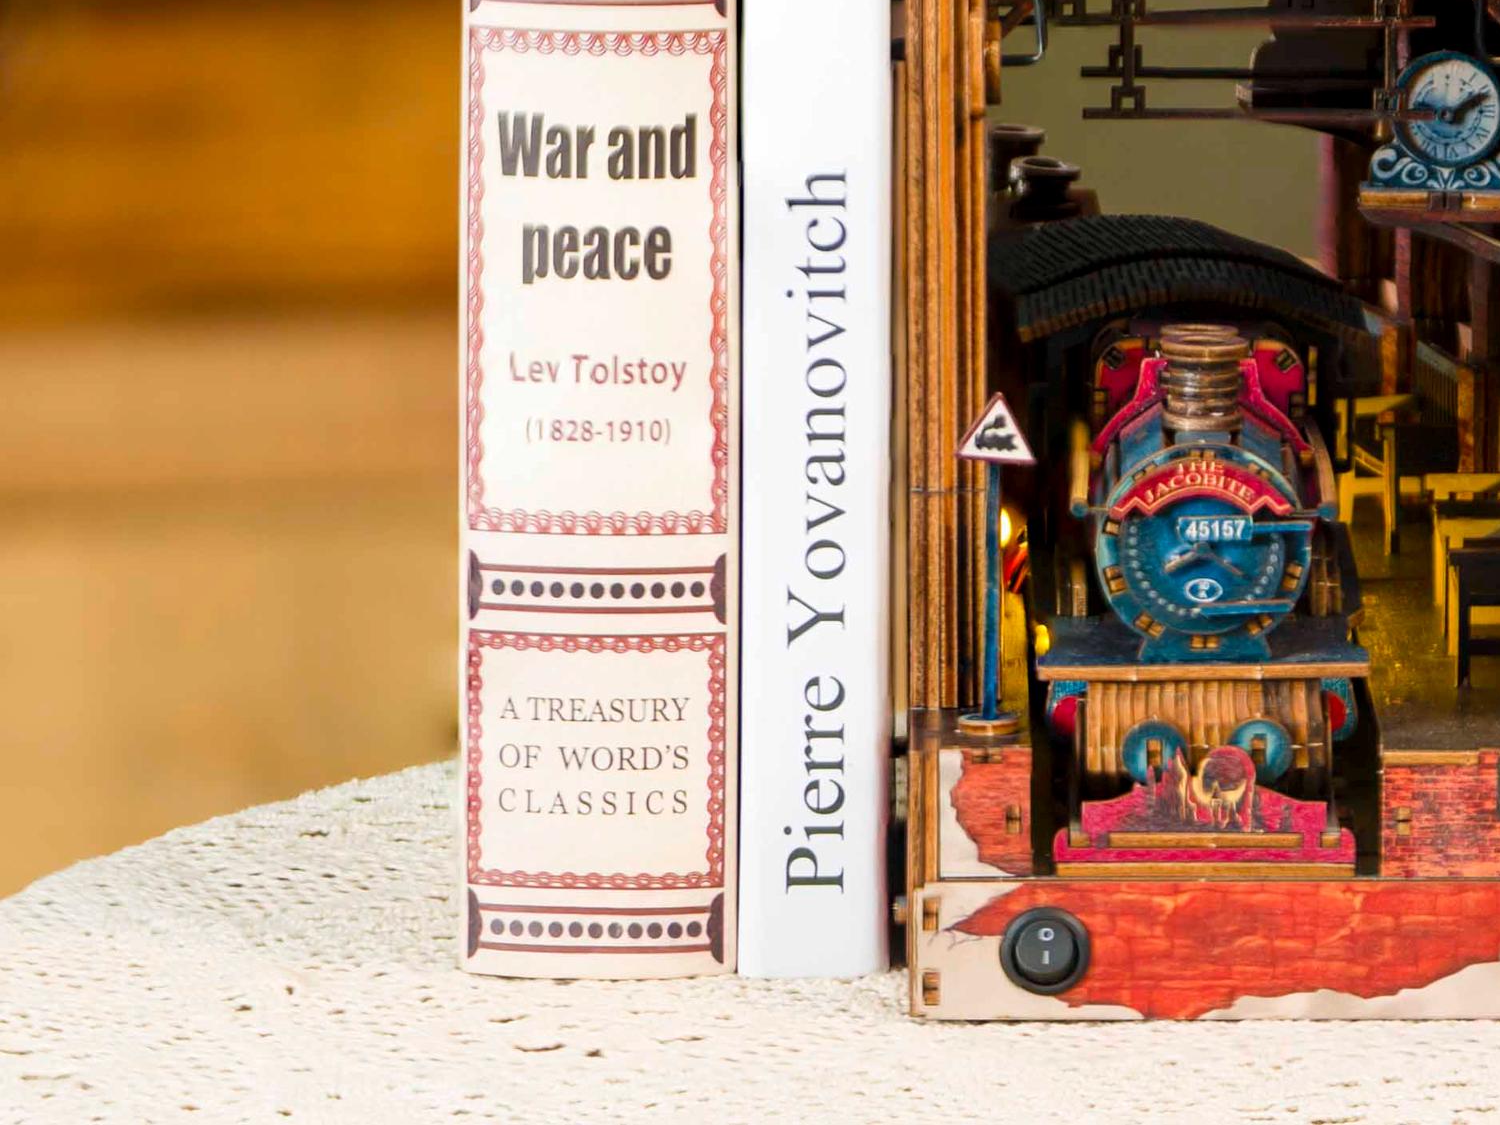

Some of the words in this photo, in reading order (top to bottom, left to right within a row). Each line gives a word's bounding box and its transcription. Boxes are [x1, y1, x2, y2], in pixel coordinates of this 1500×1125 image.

[498, 110, 595, 179] War
[607, 112, 698, 180] and
[521, 223, 673, 285] peace
[509, 352, 561, 385] Lev
[572, 355, 687, 392] Tolstoy
[784, 168, 848, 649] Yovanovitch
[525, 417, 672, 445] (1828-1910)
[1144, 471, 1255, 504] JACOBITE
[1185, 519, 1246, 541] 45157
[500, 697, 521, 721] A
[527, 697, 690, 722] TREASURY
[499, 744, 541, 769] OF
[560, 745, 689, 771] WORD'S
[784, 675, 846, 895] Pierre
[498, 788, 689, 816] CLASSICS
